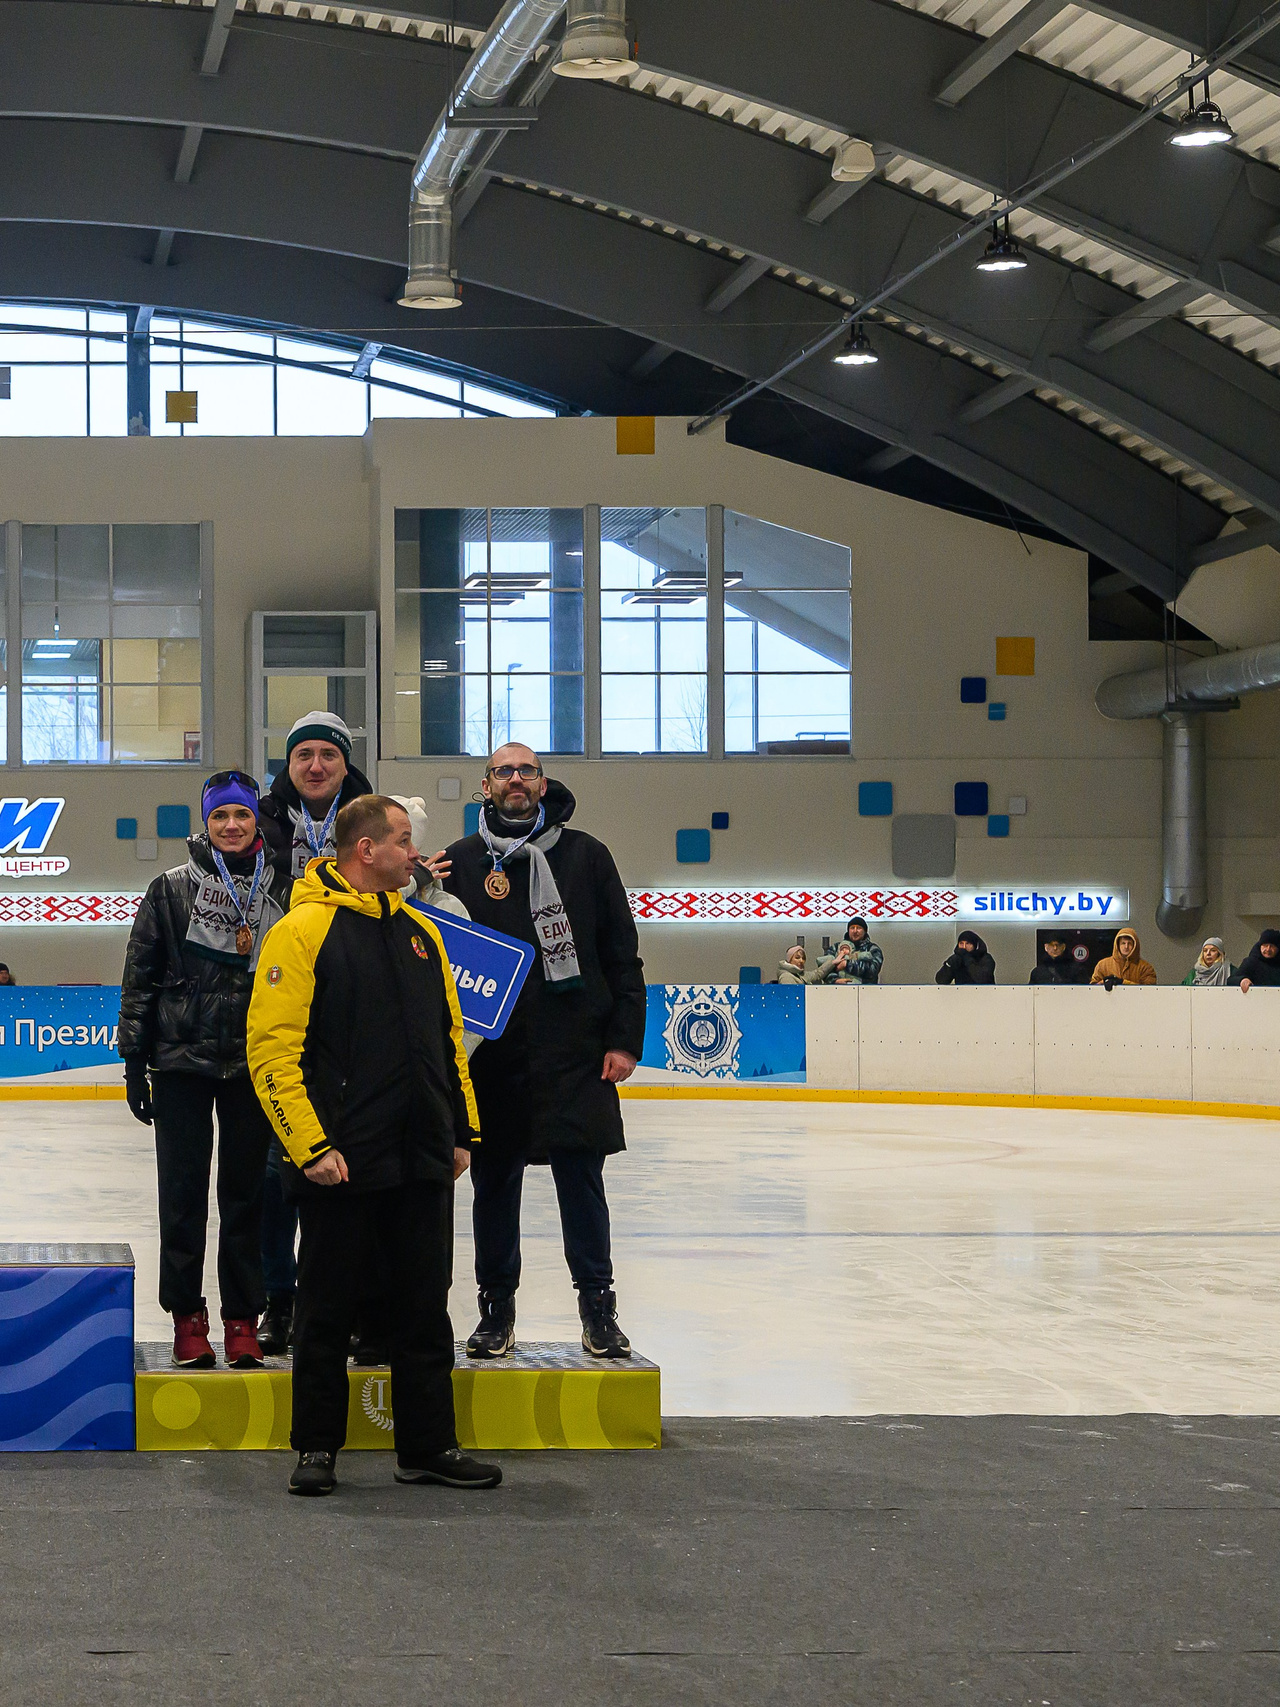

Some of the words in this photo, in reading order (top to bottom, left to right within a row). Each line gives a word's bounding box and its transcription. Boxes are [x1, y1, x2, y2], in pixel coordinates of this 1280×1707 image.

[6, 861, 65, 873] ЦЕНТР
[974, 892, 1113, 915] silichy.by
[542, 920, 571, 939] ЕДИ
[449, 963, 497, 998] ные
[14, 1019, 119, 1052] Презид
[265, 1073, 294, 1137] BELARUS
